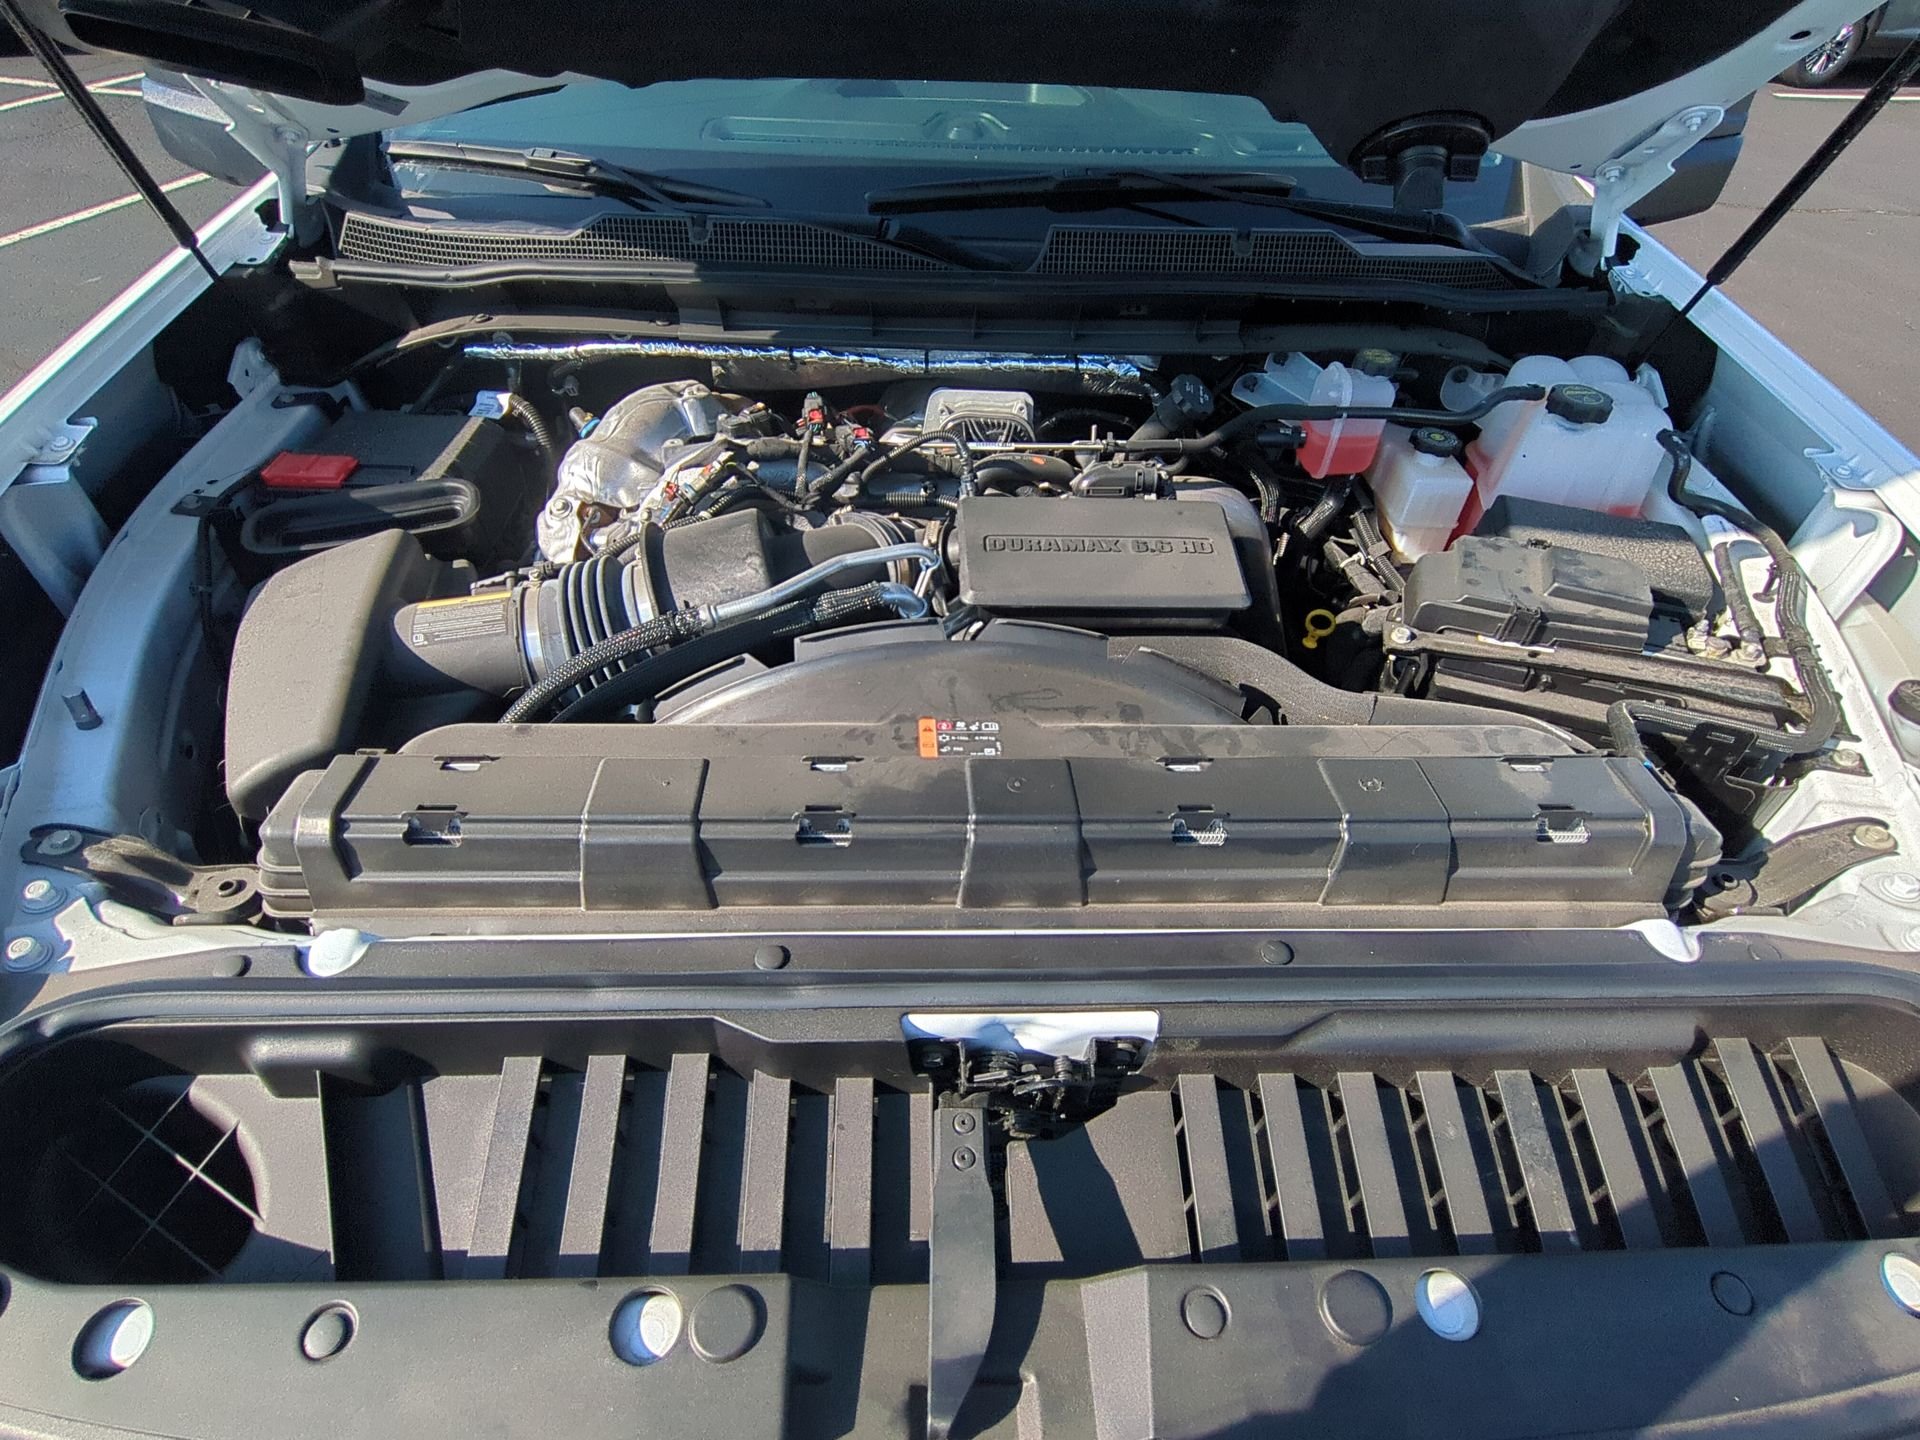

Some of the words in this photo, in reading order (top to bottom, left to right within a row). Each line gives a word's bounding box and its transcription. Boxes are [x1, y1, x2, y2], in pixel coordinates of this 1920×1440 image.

[988, 537, 1122, 553] DURAMAX
[1132, 540, 1174, 554] 6.6
[1179, 540, 1215, 555] HD
